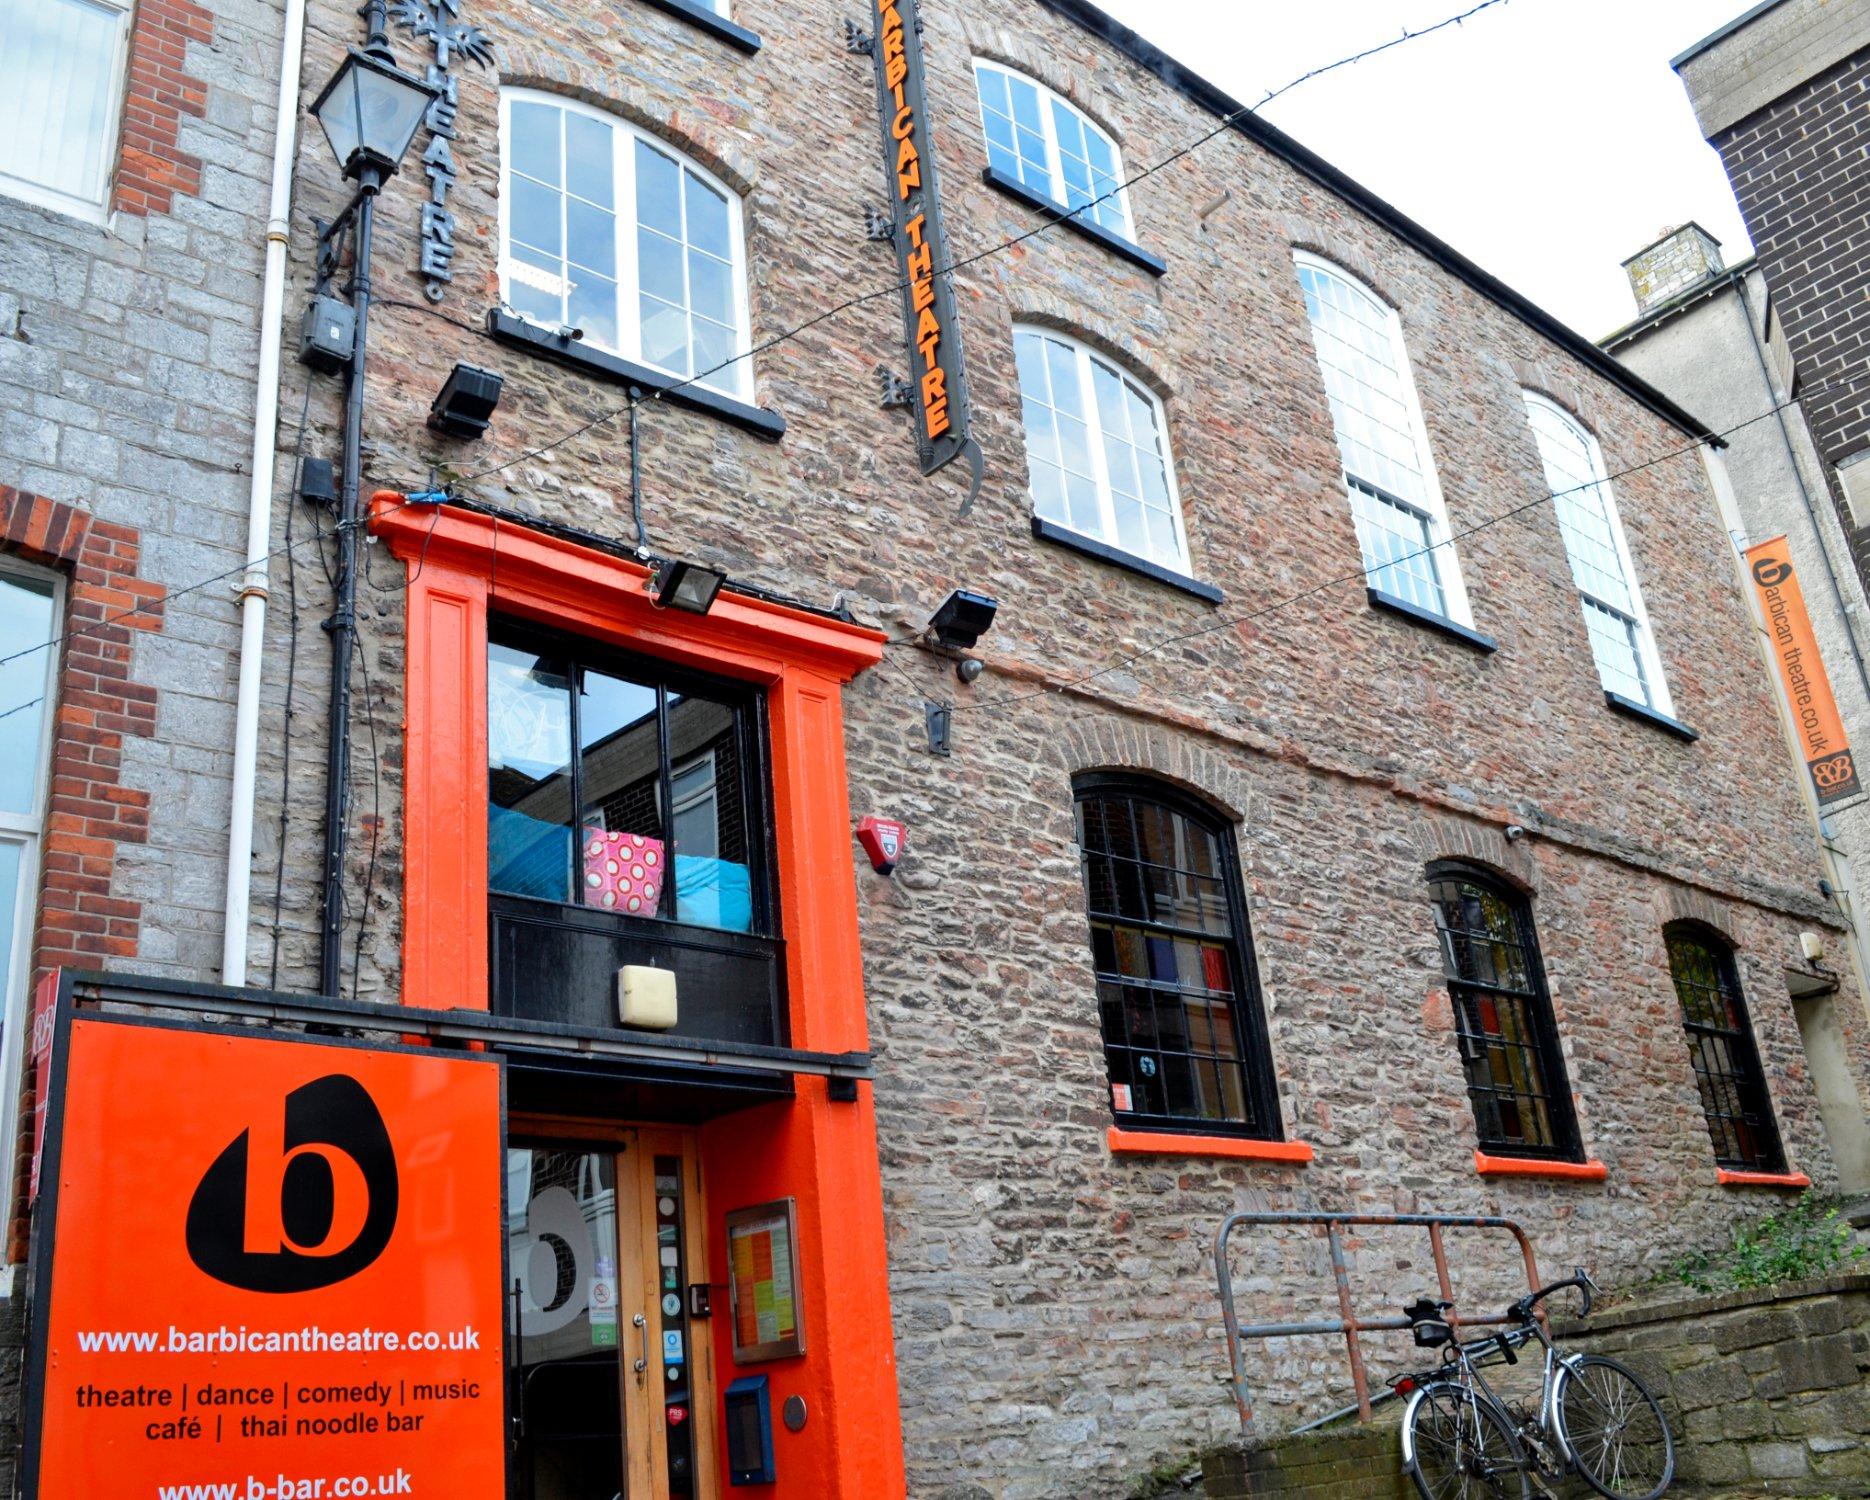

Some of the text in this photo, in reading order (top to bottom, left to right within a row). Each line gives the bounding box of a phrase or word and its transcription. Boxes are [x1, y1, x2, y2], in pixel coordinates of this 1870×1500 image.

[420, 31, 458, 281] THEATRE
[905, 214, 949, 439] THEATRE
[1784, 646, 1827, 755] theatre.co.uk
[77, 1325, 480, 1353] www.barbicantheatre.co.uk
[76, 1384, 172, 1408] theatre
[196, 1383, 274, 1406] dance
[297, 1381, 392, 1407] comedy
[413, 1379, 480, 1400] music
[145, 1416, 202, 1441] café
[240, 1415, 287, 1438] thai
[296, 1412, 379, 1436] noodle
[386, 1411, 424, 1433] bar
[158, 1468, 412, 1500] www.b-bar.co.uk
